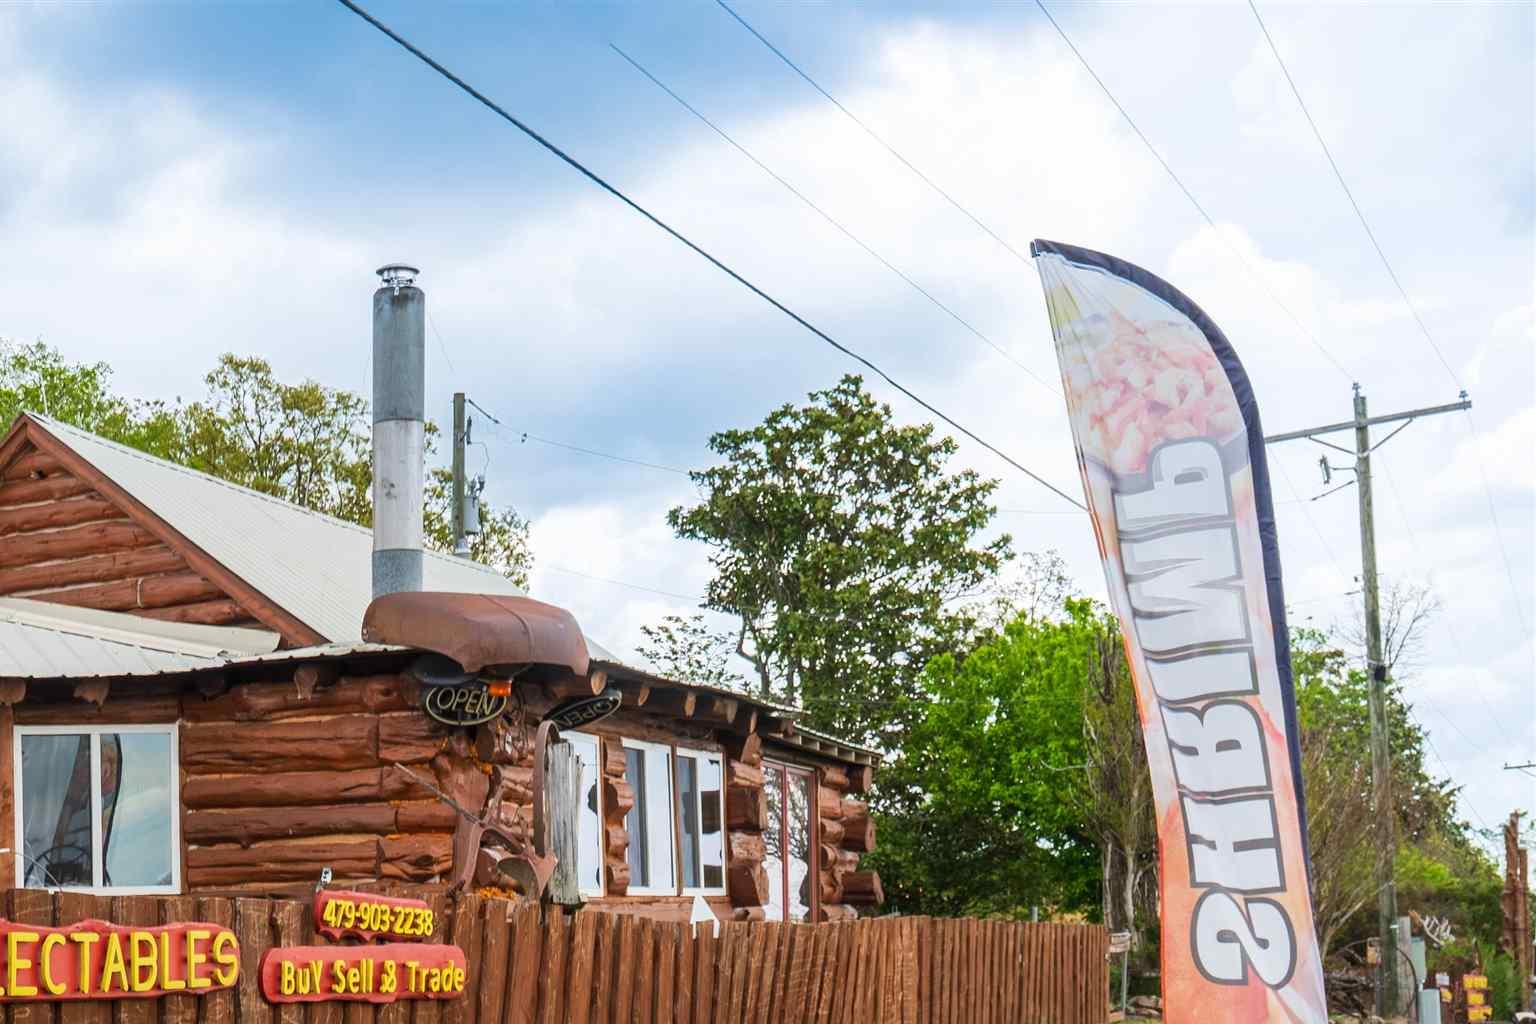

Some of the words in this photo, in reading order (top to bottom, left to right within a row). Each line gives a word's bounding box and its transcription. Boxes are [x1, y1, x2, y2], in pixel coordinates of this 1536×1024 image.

[437, 685, 495, 715] OPEN
[323, 898, 434, 936] 479-903-2238
[331, 957, 374, 993] Sell
[406, 959, 464, 993] Trade
